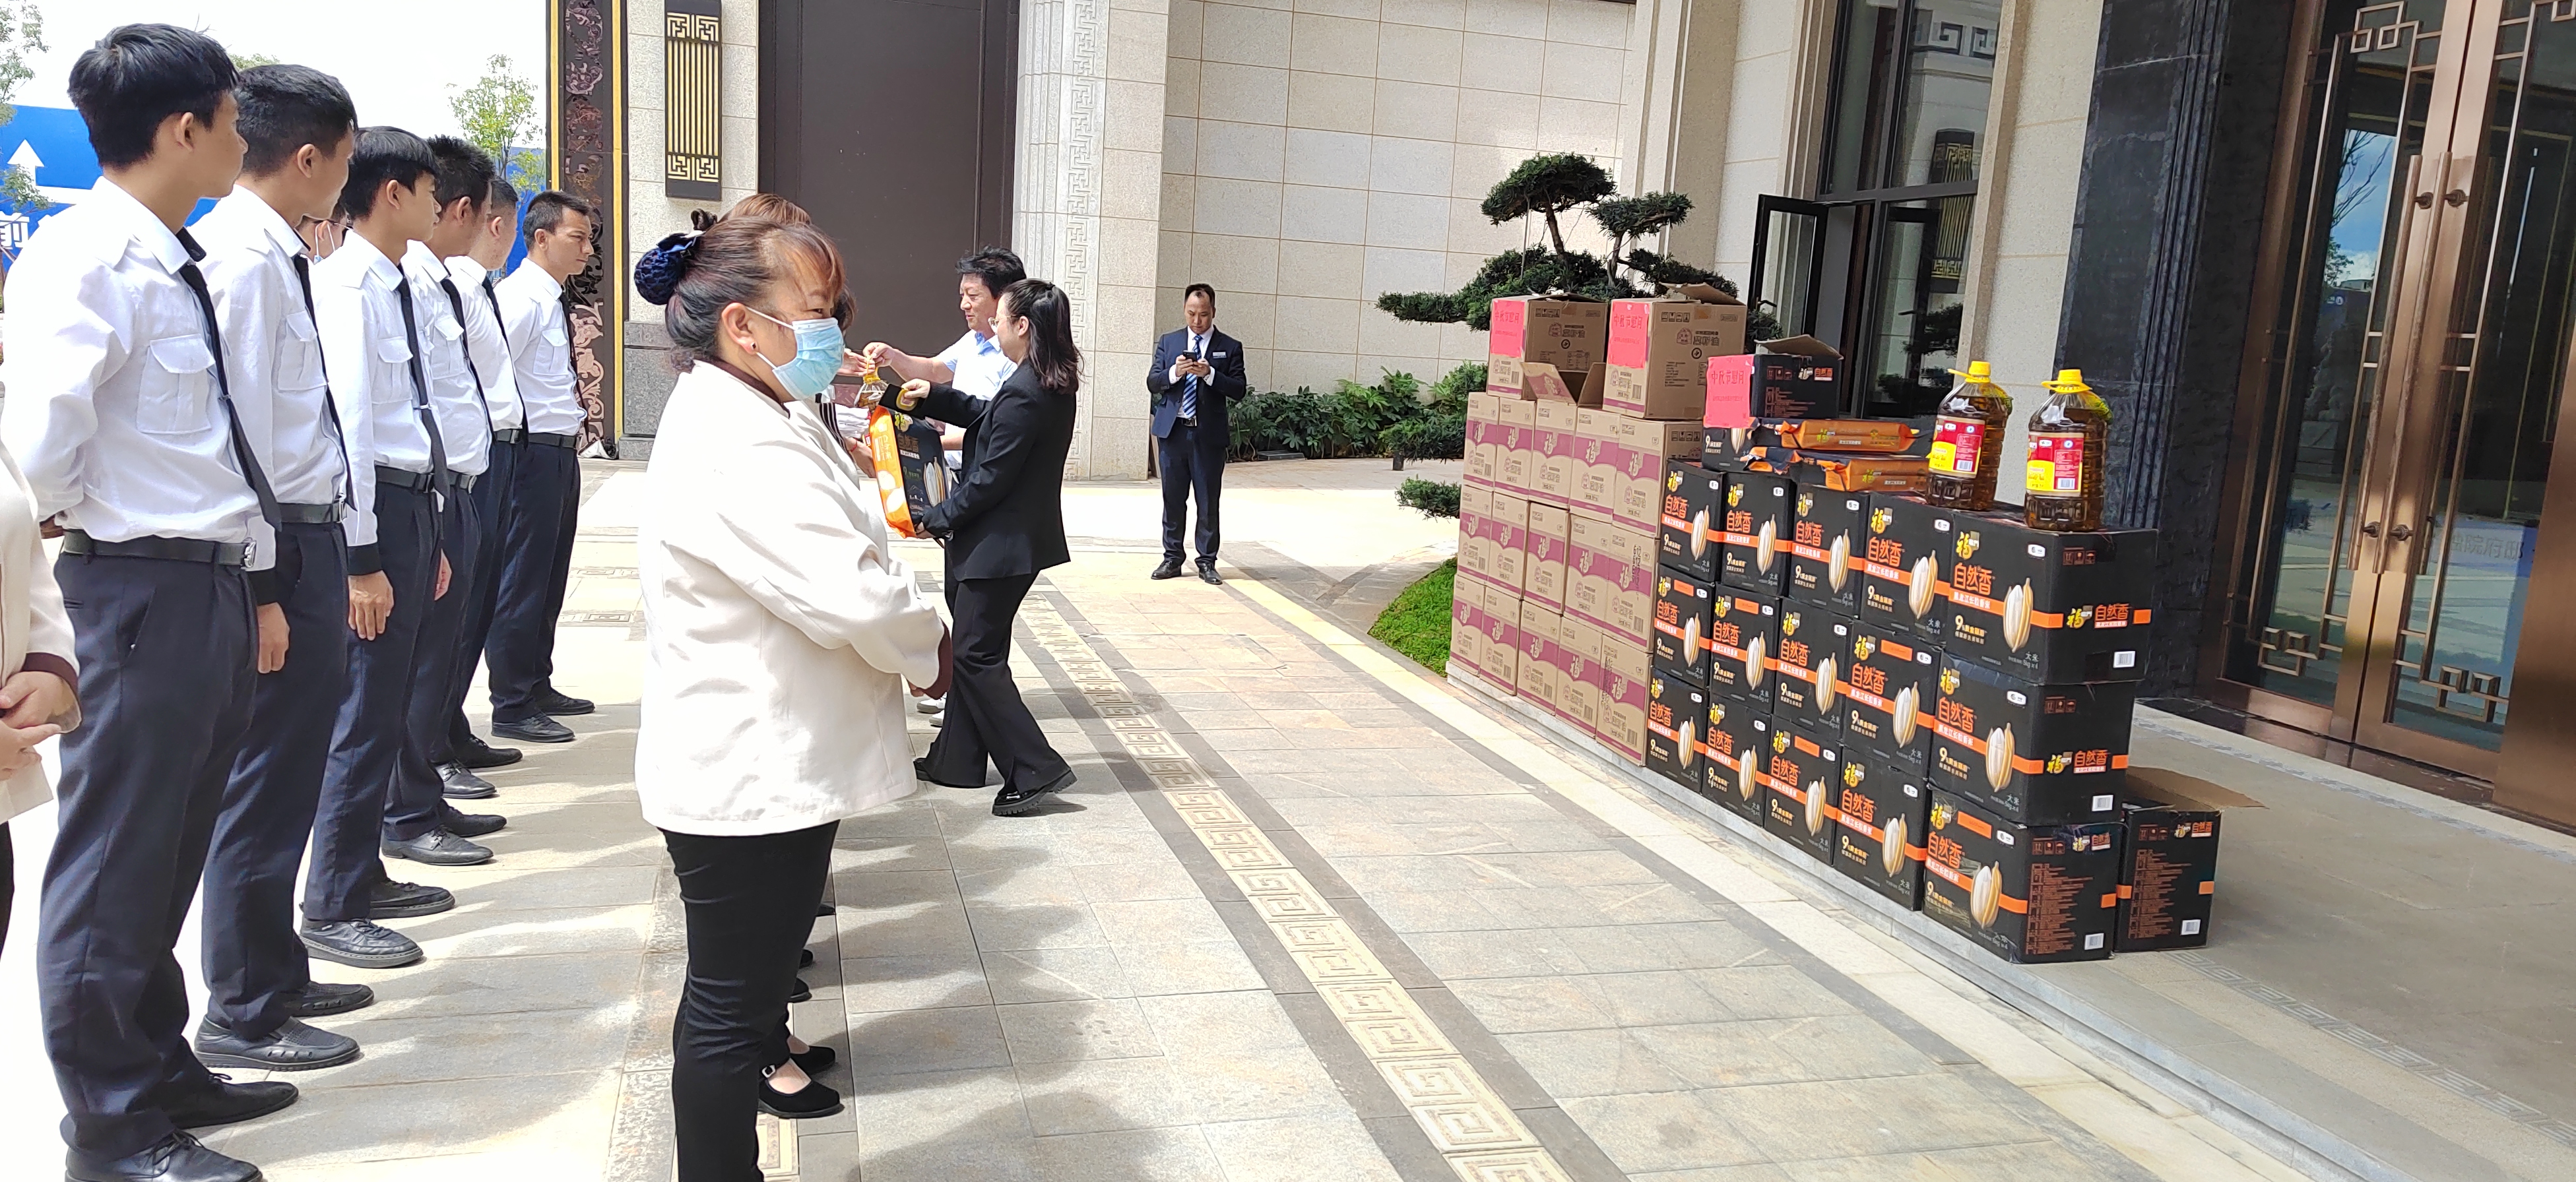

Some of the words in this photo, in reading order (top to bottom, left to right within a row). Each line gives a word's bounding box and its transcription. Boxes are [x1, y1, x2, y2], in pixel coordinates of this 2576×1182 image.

[1664, 494, 1688, 519] 自然香
[1726, 509, 1752, 534] 自然香
[1795, 520, 1823, 547] 自然香
[1868, 536, 1902, 567] 自然香
[1954, 562, 1993, 596] 自然香
[1656, 599, 1679, 625] 自然香
[2094, 603, 2131, 621] 自然香
[1713, 620, 1740, 646] 自然香
[1780, 638, 1809, 667] 自然香
[1852, 662, 1886, 695] 自然香
[1650, 700, 1673, 727] 自然香
[1938, 697, 1974, 733] 自然香
[1708, 726, 1733, 755] 自然香
[1771, 755, 1800, 787] 自然香
[2074, 749, 2109, 766] 自然香
[1842, 789, 1875, 823] 自然香
[1927, 831, 1962, 869] 自然香
